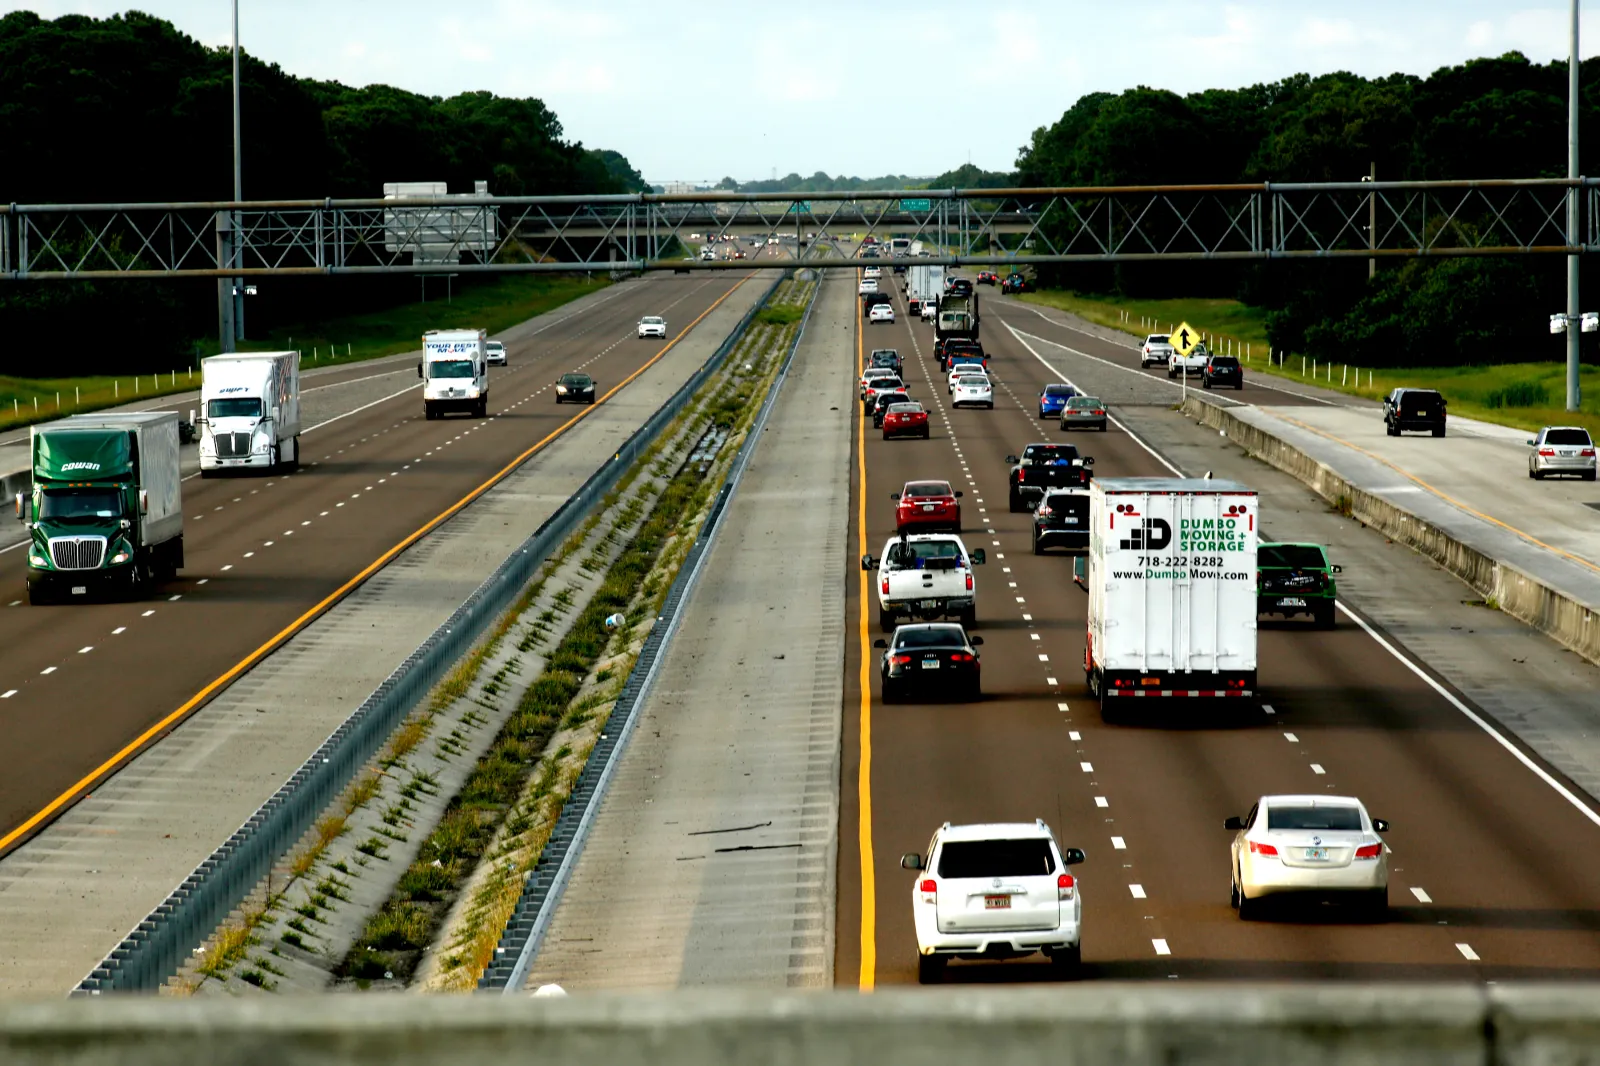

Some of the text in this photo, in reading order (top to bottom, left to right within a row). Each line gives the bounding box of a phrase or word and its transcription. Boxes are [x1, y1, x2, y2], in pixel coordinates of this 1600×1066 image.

[1181, 519, 1236, 529] DUMBO
[1181, 530, 1235, 540] MOVING
[1181, 541, 1245, 551] STORAGE
[1137, 556, 1224, 567] 718-222-8282
